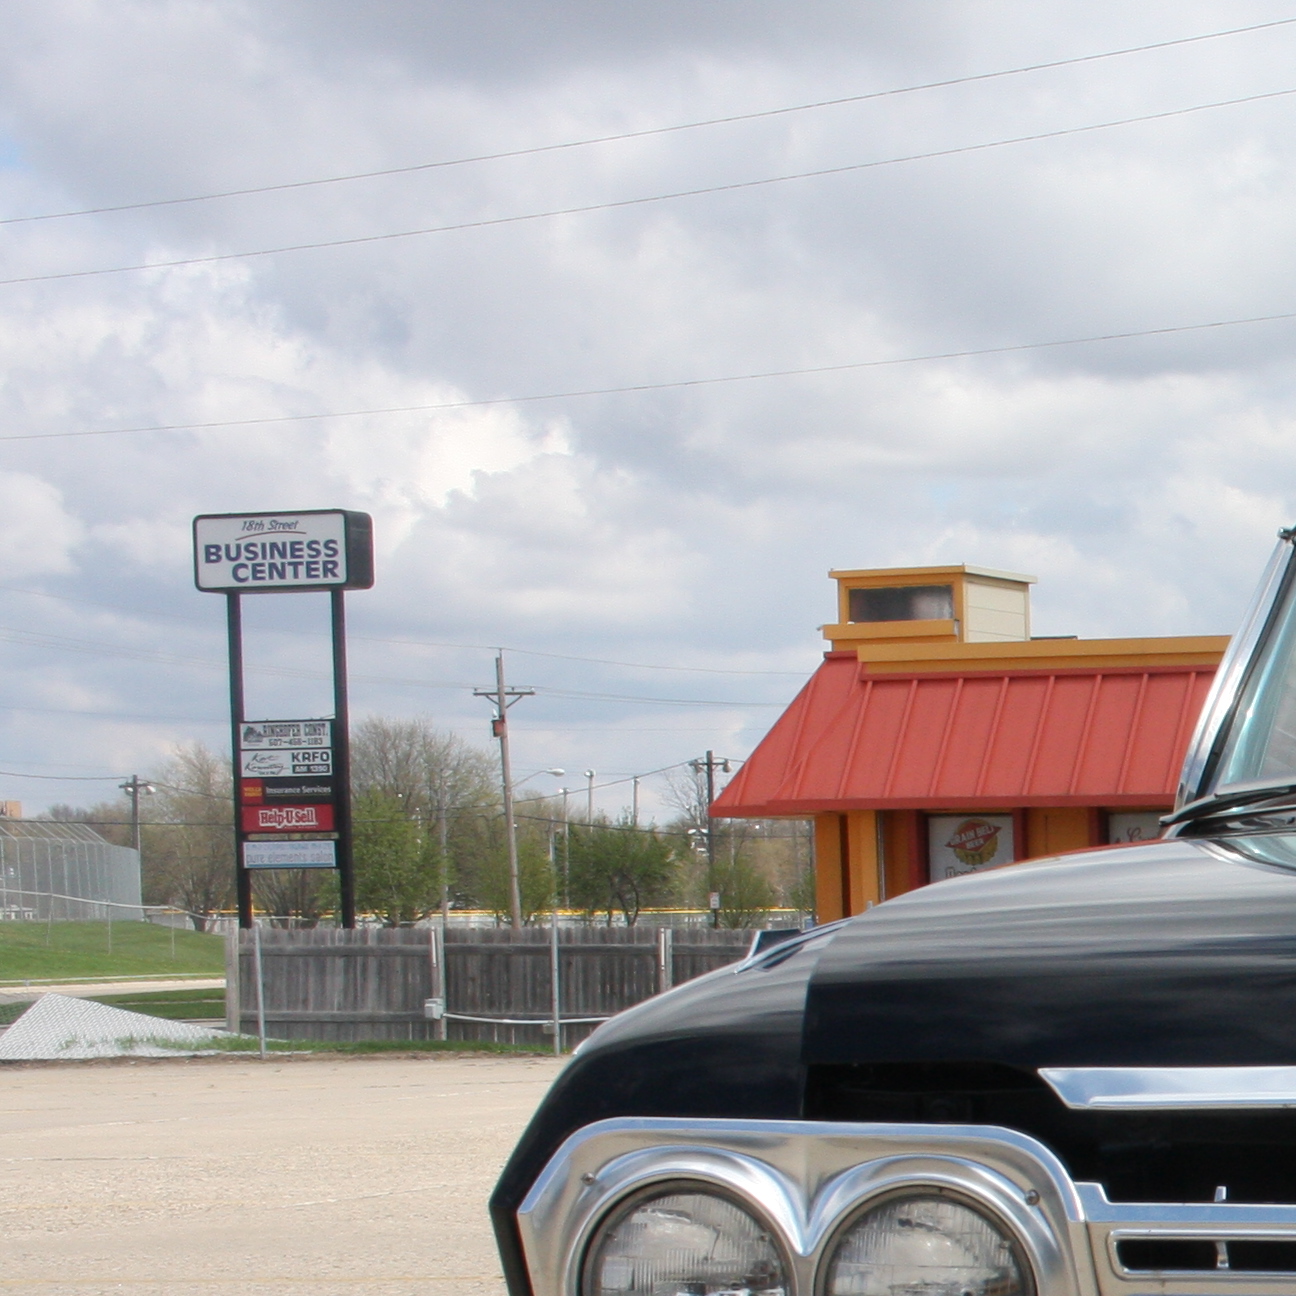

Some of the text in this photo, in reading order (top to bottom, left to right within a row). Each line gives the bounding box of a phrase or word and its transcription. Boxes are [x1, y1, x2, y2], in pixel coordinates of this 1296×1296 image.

[241, 519, 299, 531] 18th Street
[204, 539, 339, 564] BUSINESS
[231, 560, 340, 583] CENTER
[291, 751, 330, 763] KRFO
[302, 785, 332, 793] Services
